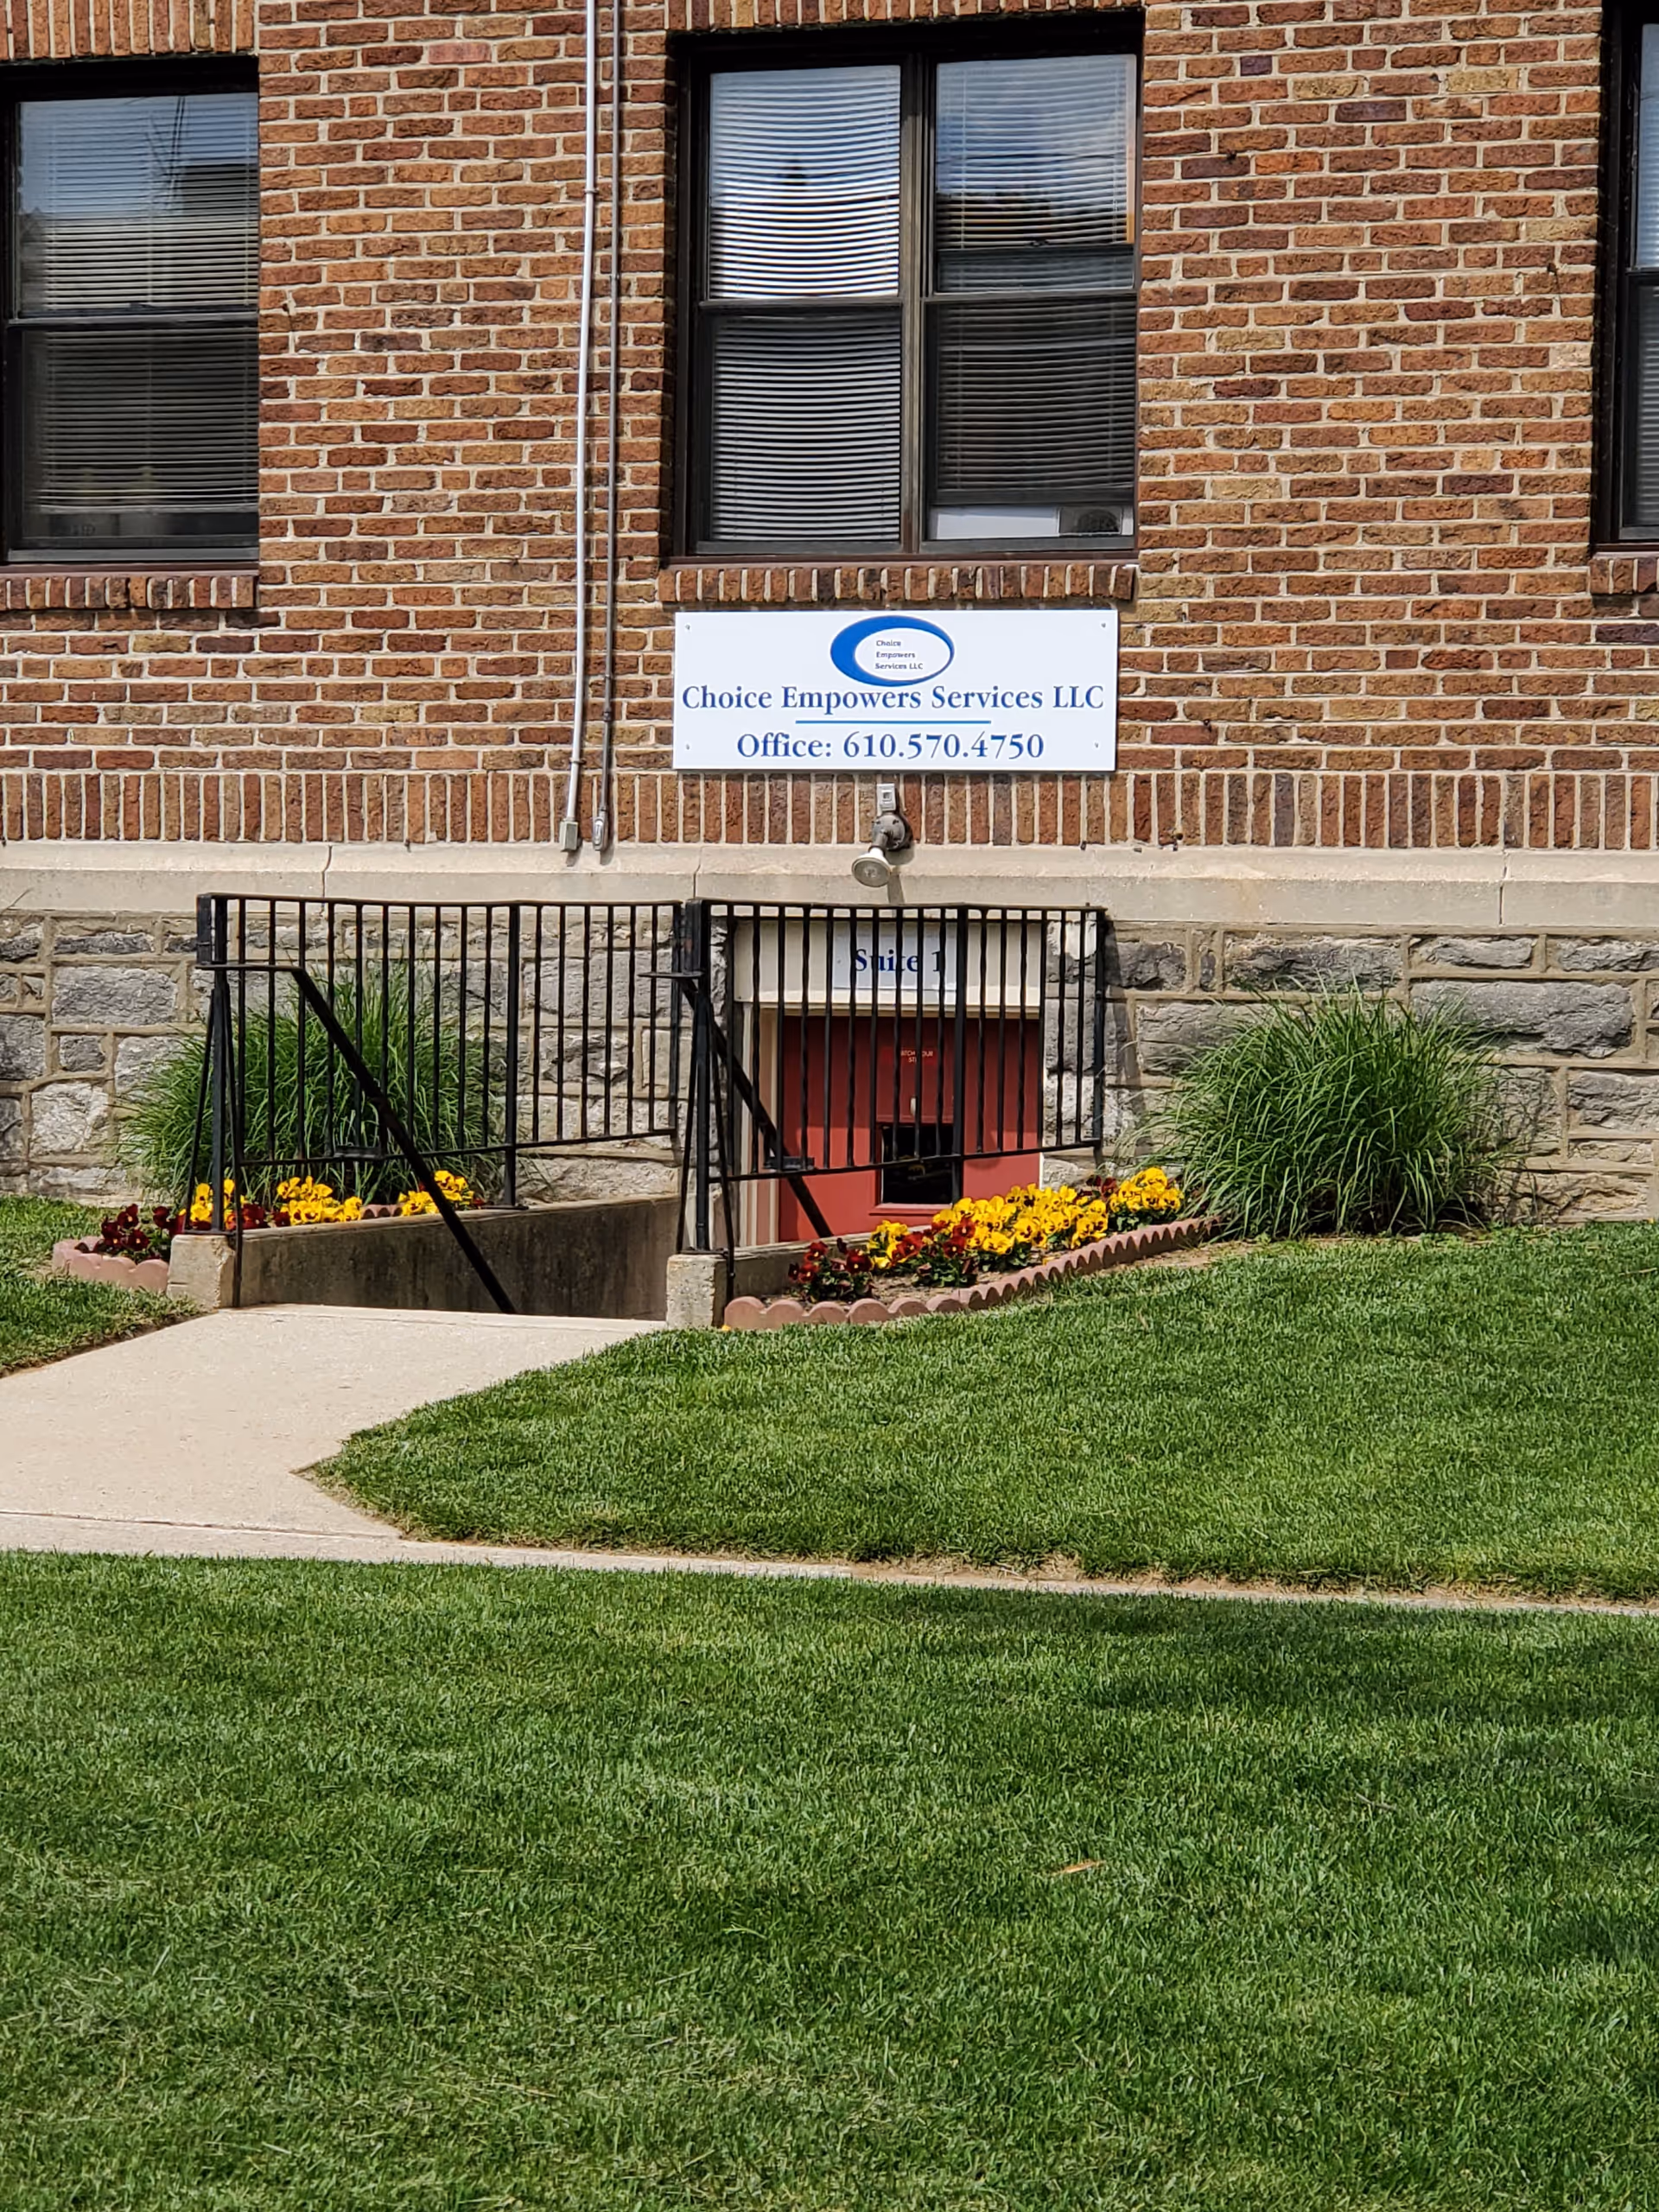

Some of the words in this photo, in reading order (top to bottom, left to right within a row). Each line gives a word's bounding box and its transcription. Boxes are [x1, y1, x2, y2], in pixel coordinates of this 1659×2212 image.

[682, 685, 772, 709] Choice
[781, 685, 922, 715] Empowers
[931, 685, 1043, 709] Services
[1052, 685, 1104, 709] LLC
[737, 733, 831, 759] Office:
[843, 731, 1045, 760] 610.570.4750
